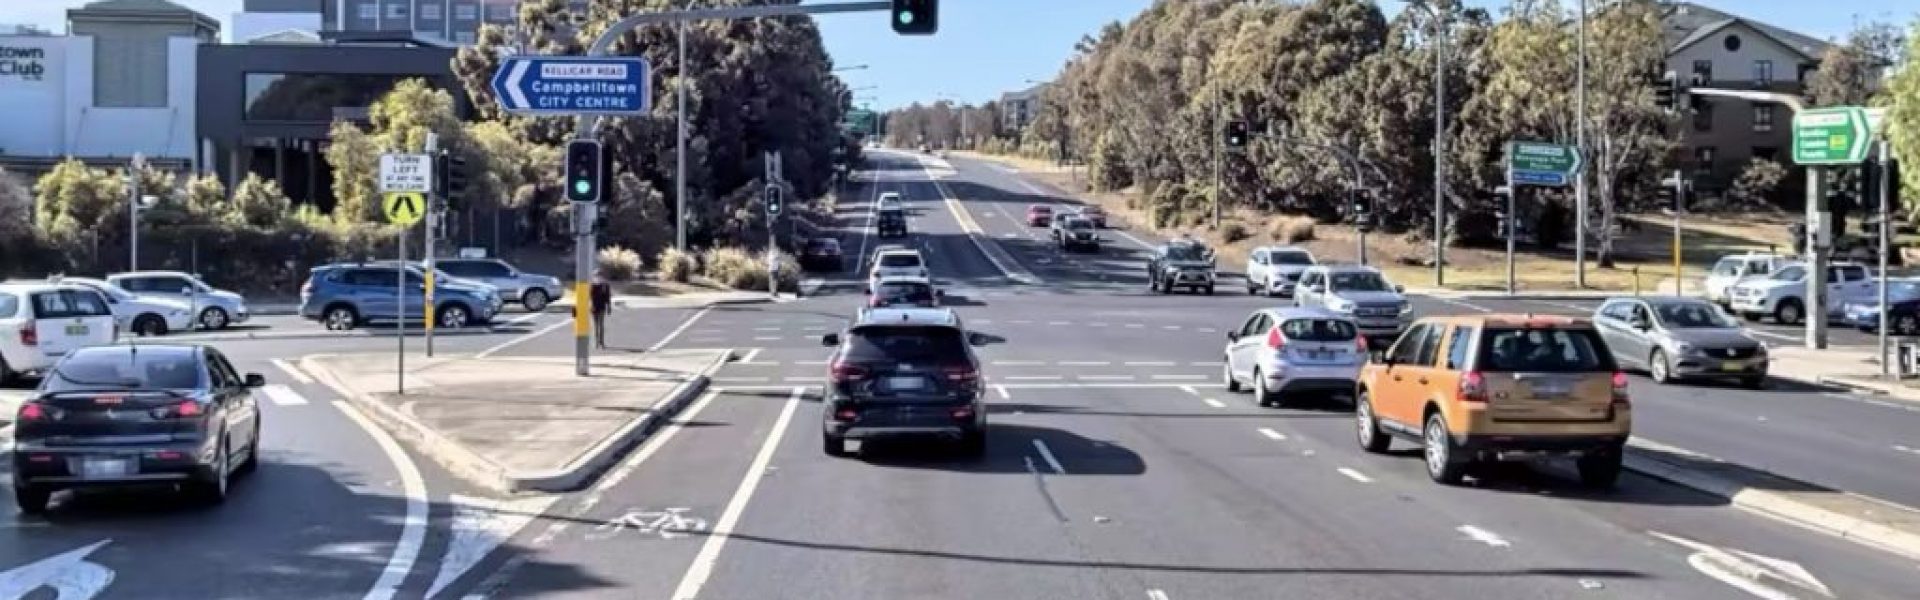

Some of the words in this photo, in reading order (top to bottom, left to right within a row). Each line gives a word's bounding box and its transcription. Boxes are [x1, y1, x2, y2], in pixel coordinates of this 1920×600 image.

[0, 61, 44, 75] Club
[531, 80, 637, 95] Campbelltown
[539, 97, 569, 108] CITY
[575, 97, 629, 108] CENTRE
[393, 165, 418, 174] LEFT
